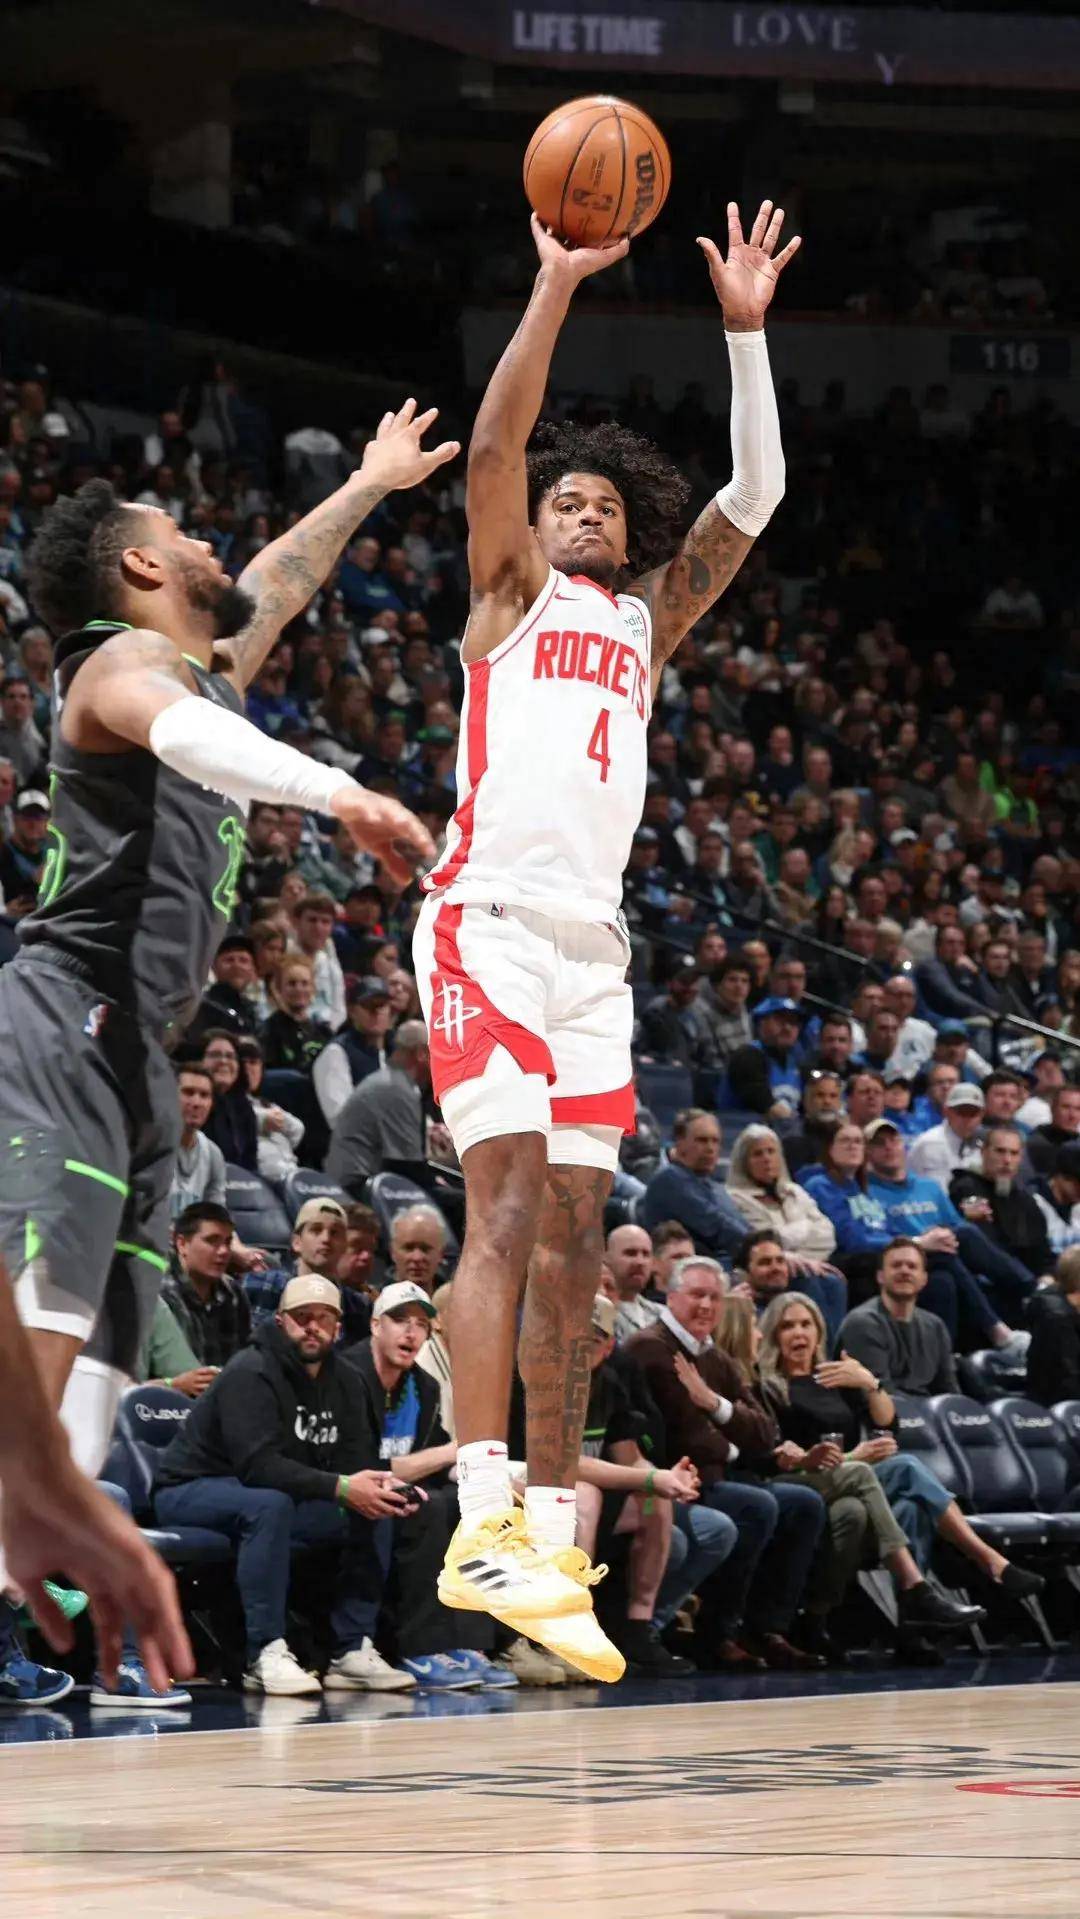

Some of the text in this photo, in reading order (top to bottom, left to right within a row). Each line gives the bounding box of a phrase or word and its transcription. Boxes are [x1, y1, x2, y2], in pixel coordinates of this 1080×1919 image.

[732, 10, 858, 52] LOVE
[983, 340, 1039, 370] 116
[586, 707, 611, 784] 4
